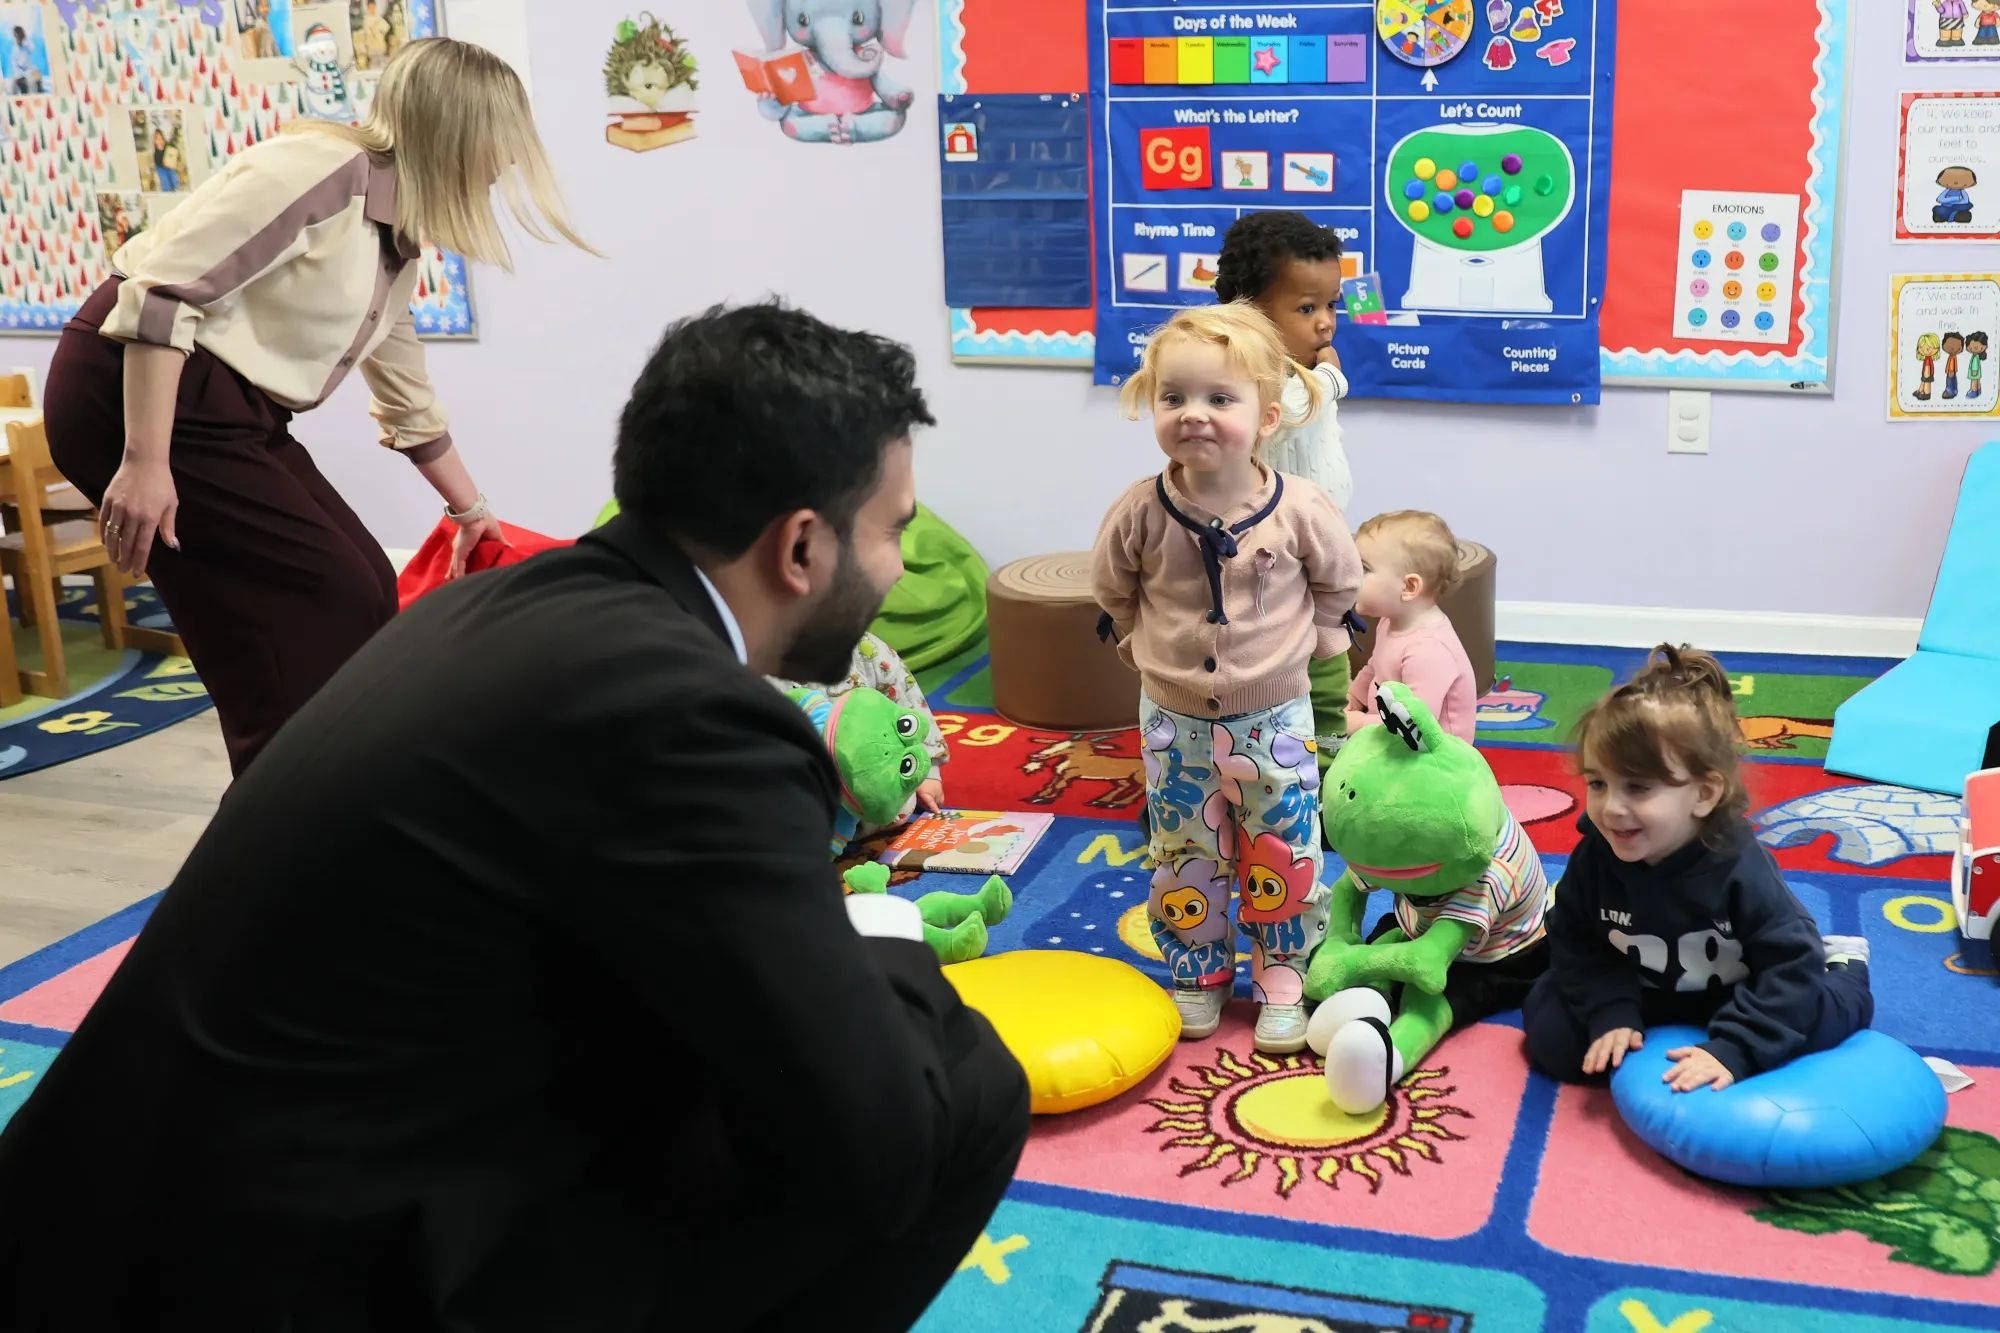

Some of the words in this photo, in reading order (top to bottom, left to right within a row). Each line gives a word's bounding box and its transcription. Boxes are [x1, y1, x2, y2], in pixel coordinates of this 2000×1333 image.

[1173, 16, 1207, 33] Days
[1209, 14, 1226, 30] of
[1228, 14, 1254, 29] the
[1255, 13, 1297, 29] Week
[1173, 108, 1221, 124] What's
[1223, 109, 1247, 124] the
[1249, 108, 1300, 124] Letter?
[1440, 102, 1474, 118] Let's
[1476, 102, 1523, 118] Count
[1942, 108, 1961, 119] We
[1963, 108, 1993, 120] keep
[1940, 124, 1975, 134] hands
[1978, 124, 2000, 134] and
[1966, 139, 1978, 148] to
[1146, 137, 1203, 182] Gg
[1712, 204, 1765, 215] EMOTIONS
[1134, 222, 1179, 240] Rhyme
[1181, 222, 1216, 237] Time
[1928, 290, 1947, 300] We
[1950, 291, 1982, 300] stand
[1916, 306, 1938, 316] and
[1940, 306, 1966, 315] walk
[1939, 320, 1960, 330] line.
[1387, 343, 1430, 355] Picture
[1503, 347, 1557, 360] Counting
[1391, 357, 1426, 369] Cards
[1511, 361, 1550, 372] Pieces
[916, 829, 935, 840] THE
[921, 819, 956, 850] SNOWY
[943, 828, 968, 844] DAY
